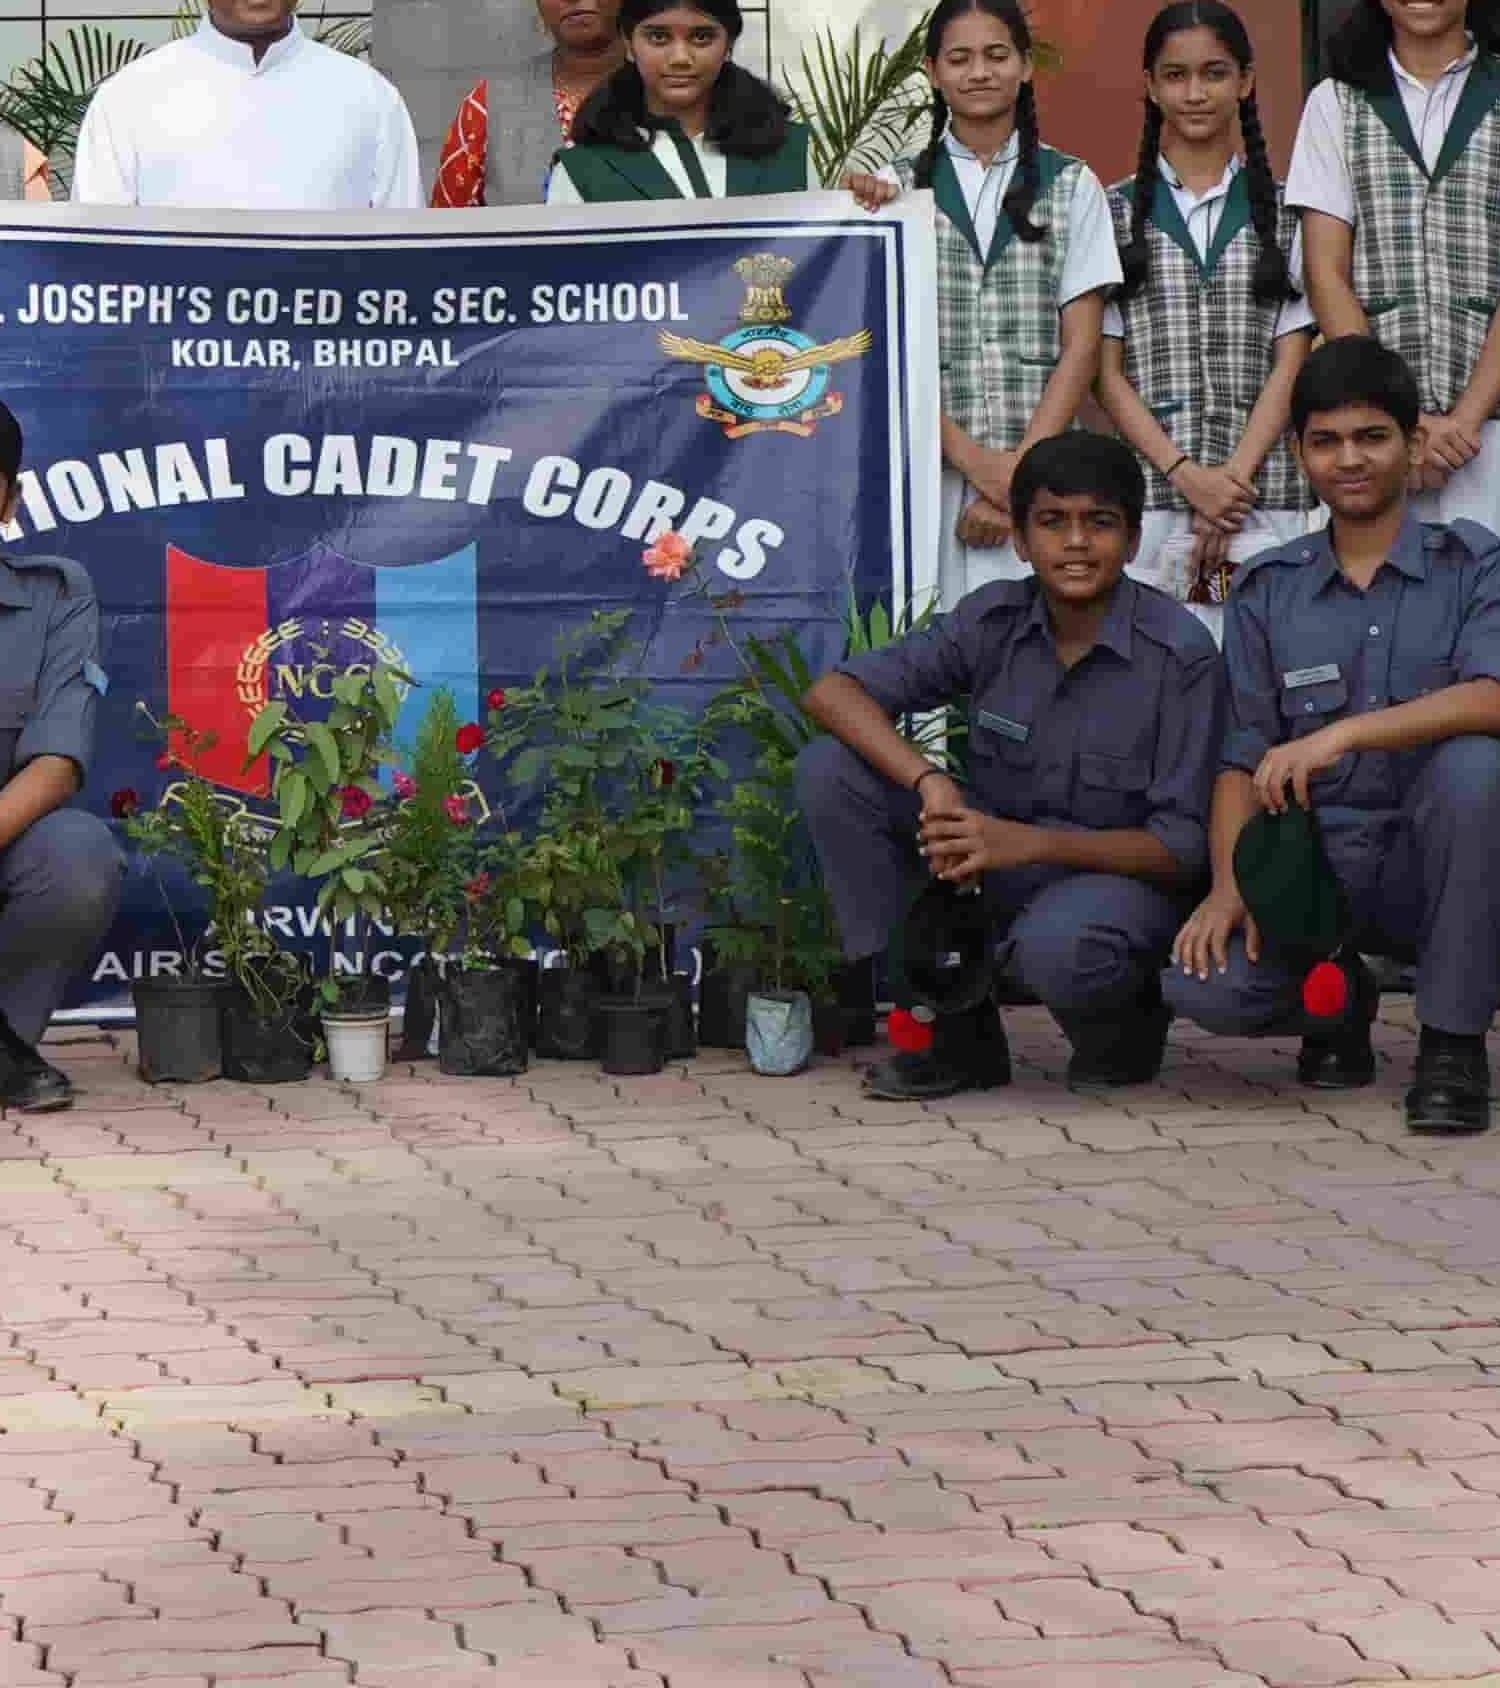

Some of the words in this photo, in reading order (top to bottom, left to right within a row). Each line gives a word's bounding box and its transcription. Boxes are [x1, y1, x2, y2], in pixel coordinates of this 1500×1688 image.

[16, 282, 212, 325] JOSEPH'S
[225, 286, 343, 326] CO-ED
[355, 288, 418, 325] SR.
[431, 285, 517, 325] SEC.
[529, 281, 690, 324] SCHOOL
[171, 338, 302, 372] KOLAR,
[312, 338, 460, 368] BHOPAL
[263, 433, 513, 506] CADET
[522, 454, 785, 580] CORPS
